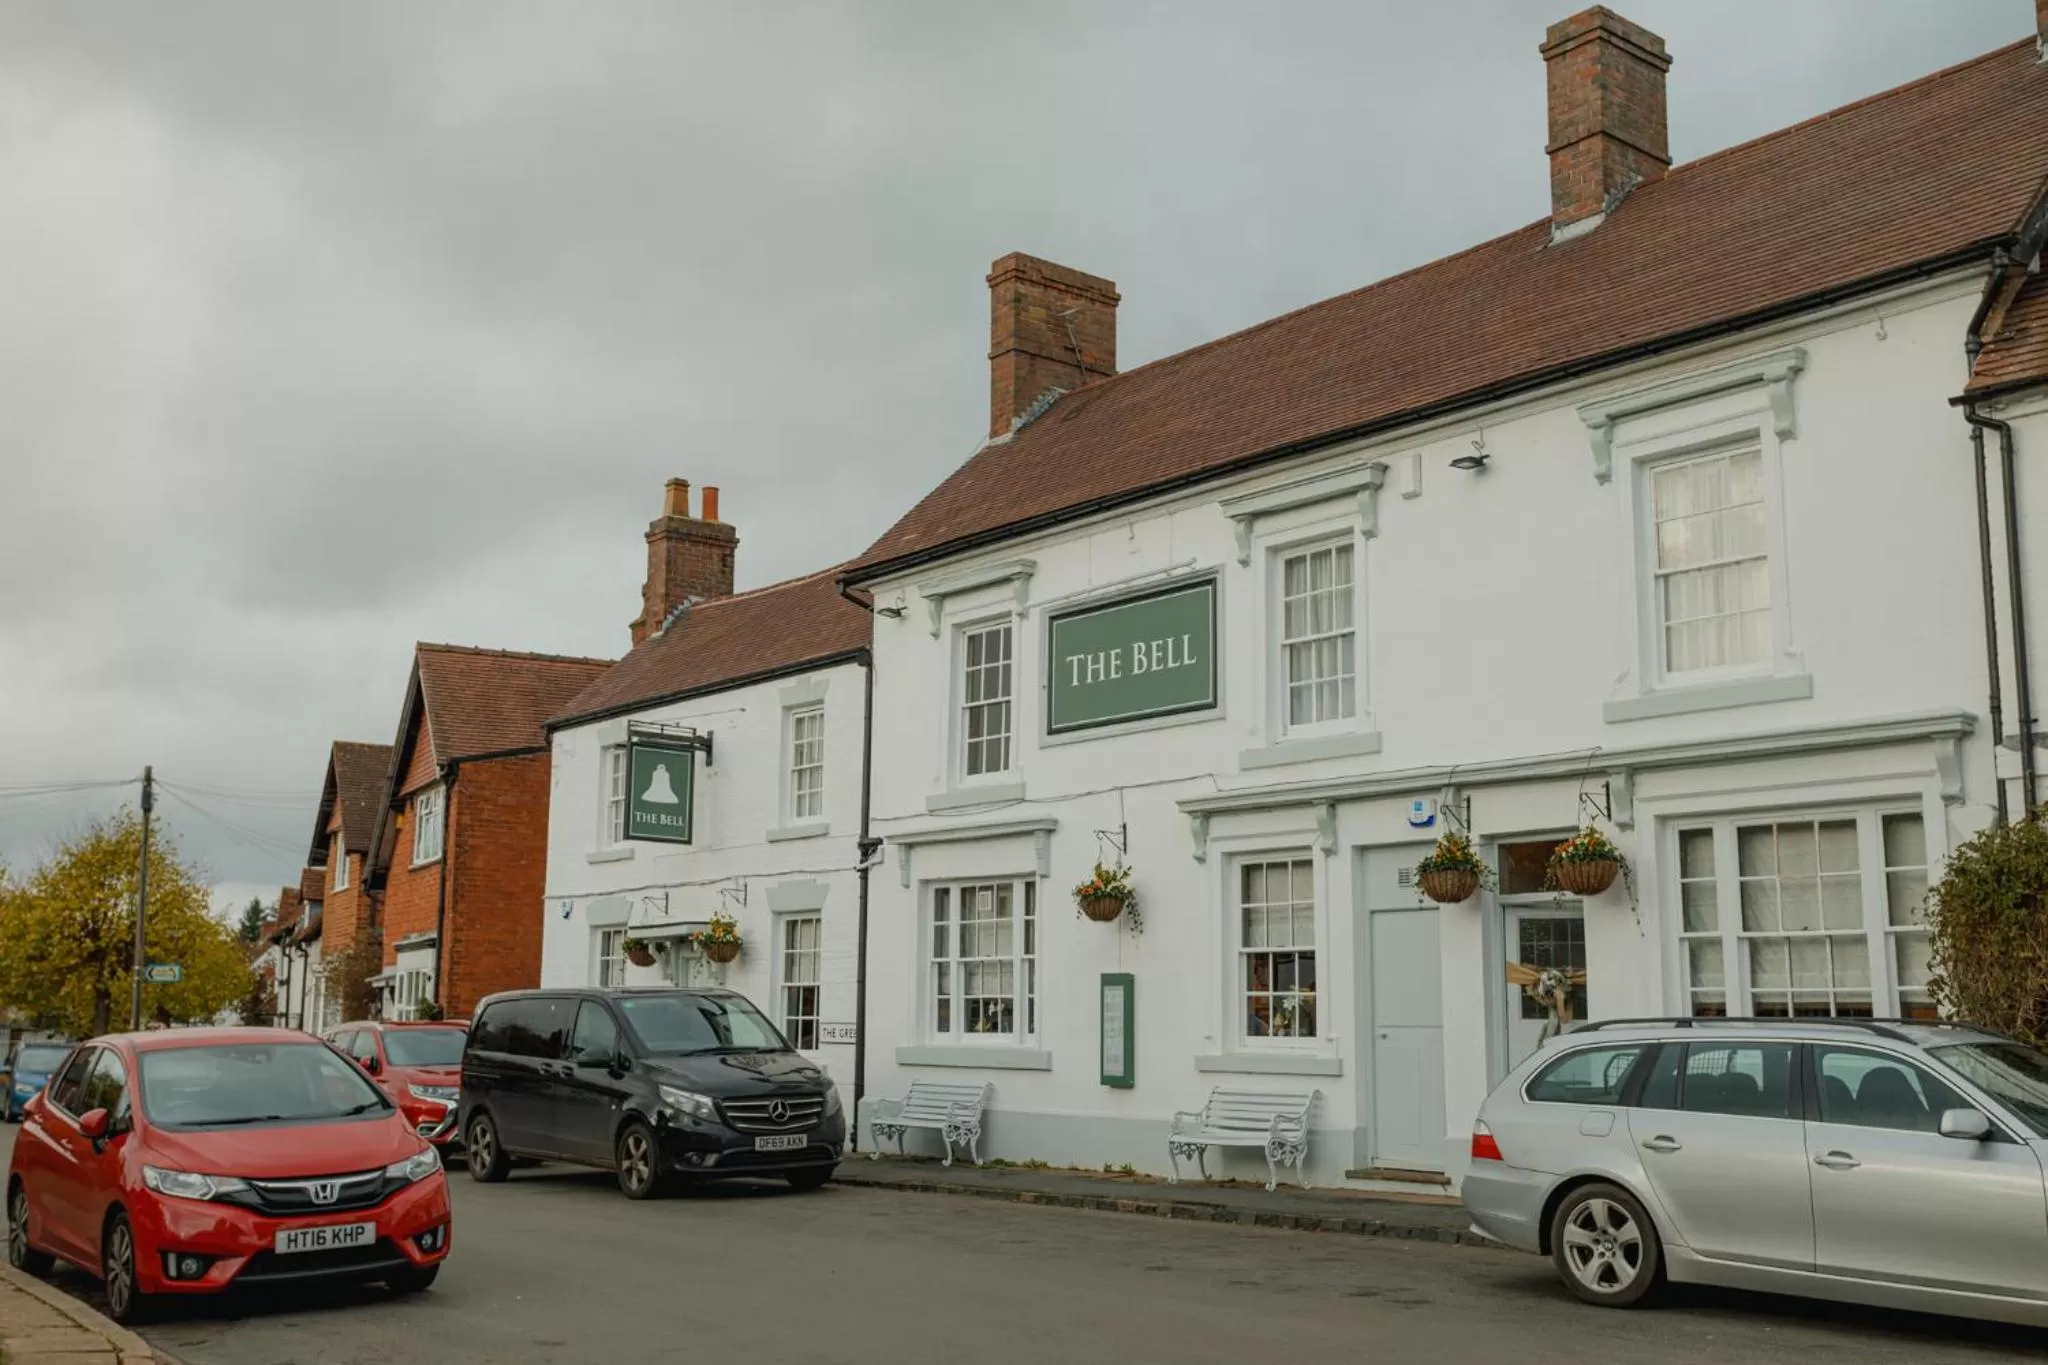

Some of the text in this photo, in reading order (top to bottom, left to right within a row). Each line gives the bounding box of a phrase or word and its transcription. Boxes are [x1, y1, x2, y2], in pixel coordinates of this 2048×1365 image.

[1065, 634, 1197, 686] THE BELL
[634, 811, 684, 826] THE BELL
[823, 1027, 837, 1038] THE
[287, 1226, 365, 1249] HT16 KHP
